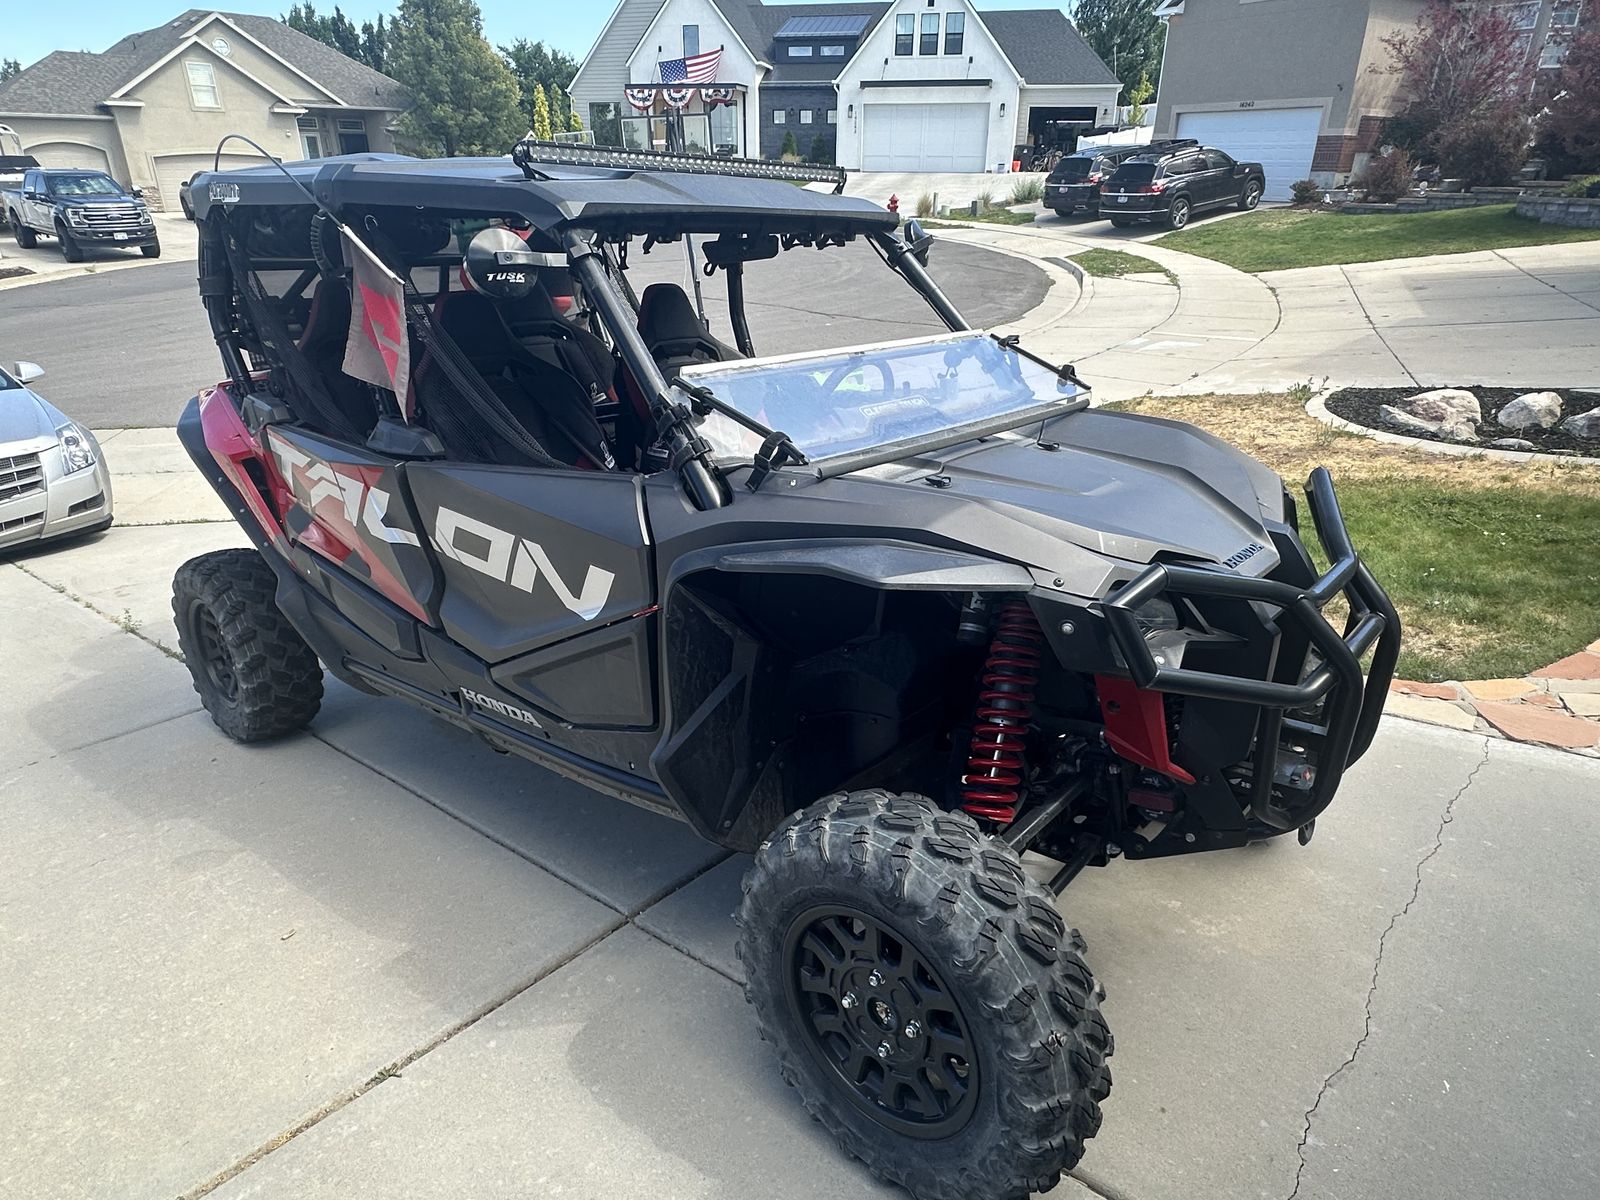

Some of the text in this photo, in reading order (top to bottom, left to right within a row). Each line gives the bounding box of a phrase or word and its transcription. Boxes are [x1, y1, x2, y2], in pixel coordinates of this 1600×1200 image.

[486, 271, 526, 281] TUSK
[267, 432, 616, 621] TALON
[460, 686, 542, 728] HONDA
